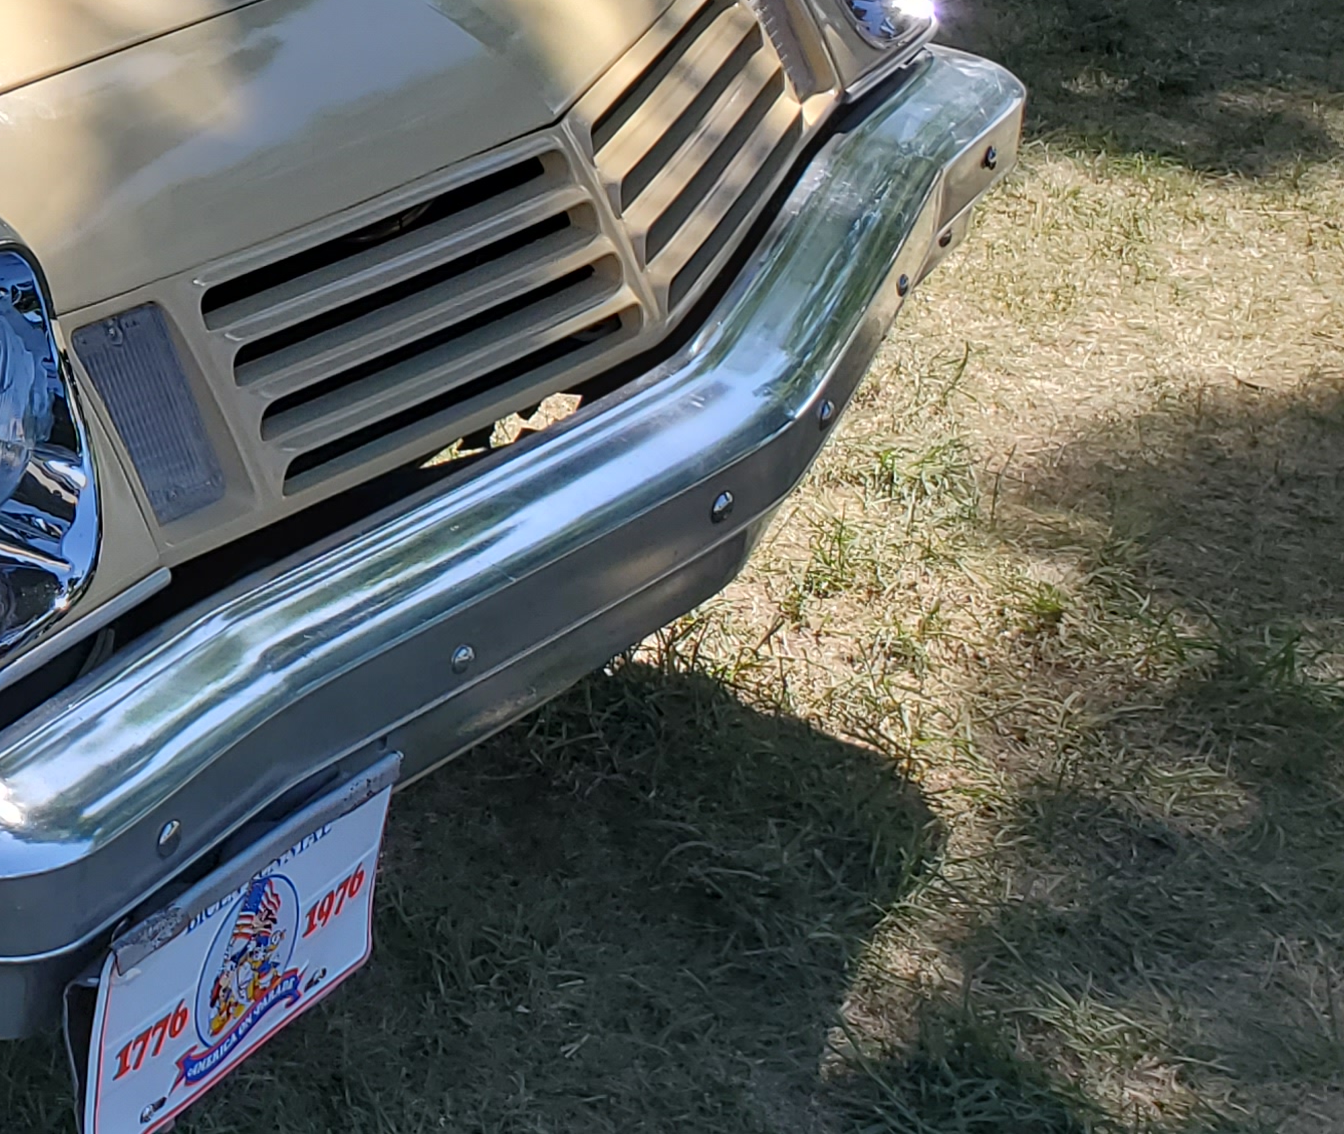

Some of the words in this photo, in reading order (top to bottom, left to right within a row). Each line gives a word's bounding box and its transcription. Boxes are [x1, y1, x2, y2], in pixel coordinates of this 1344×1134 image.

[302, 862, 366, 939] 1976
[112, 998, 189, 1081] 1776
[186, 1034, 238, 1078] AMERICA
[238, 1014, 255, 1039] ON
[253, 976, 297, 1019] PARADE
